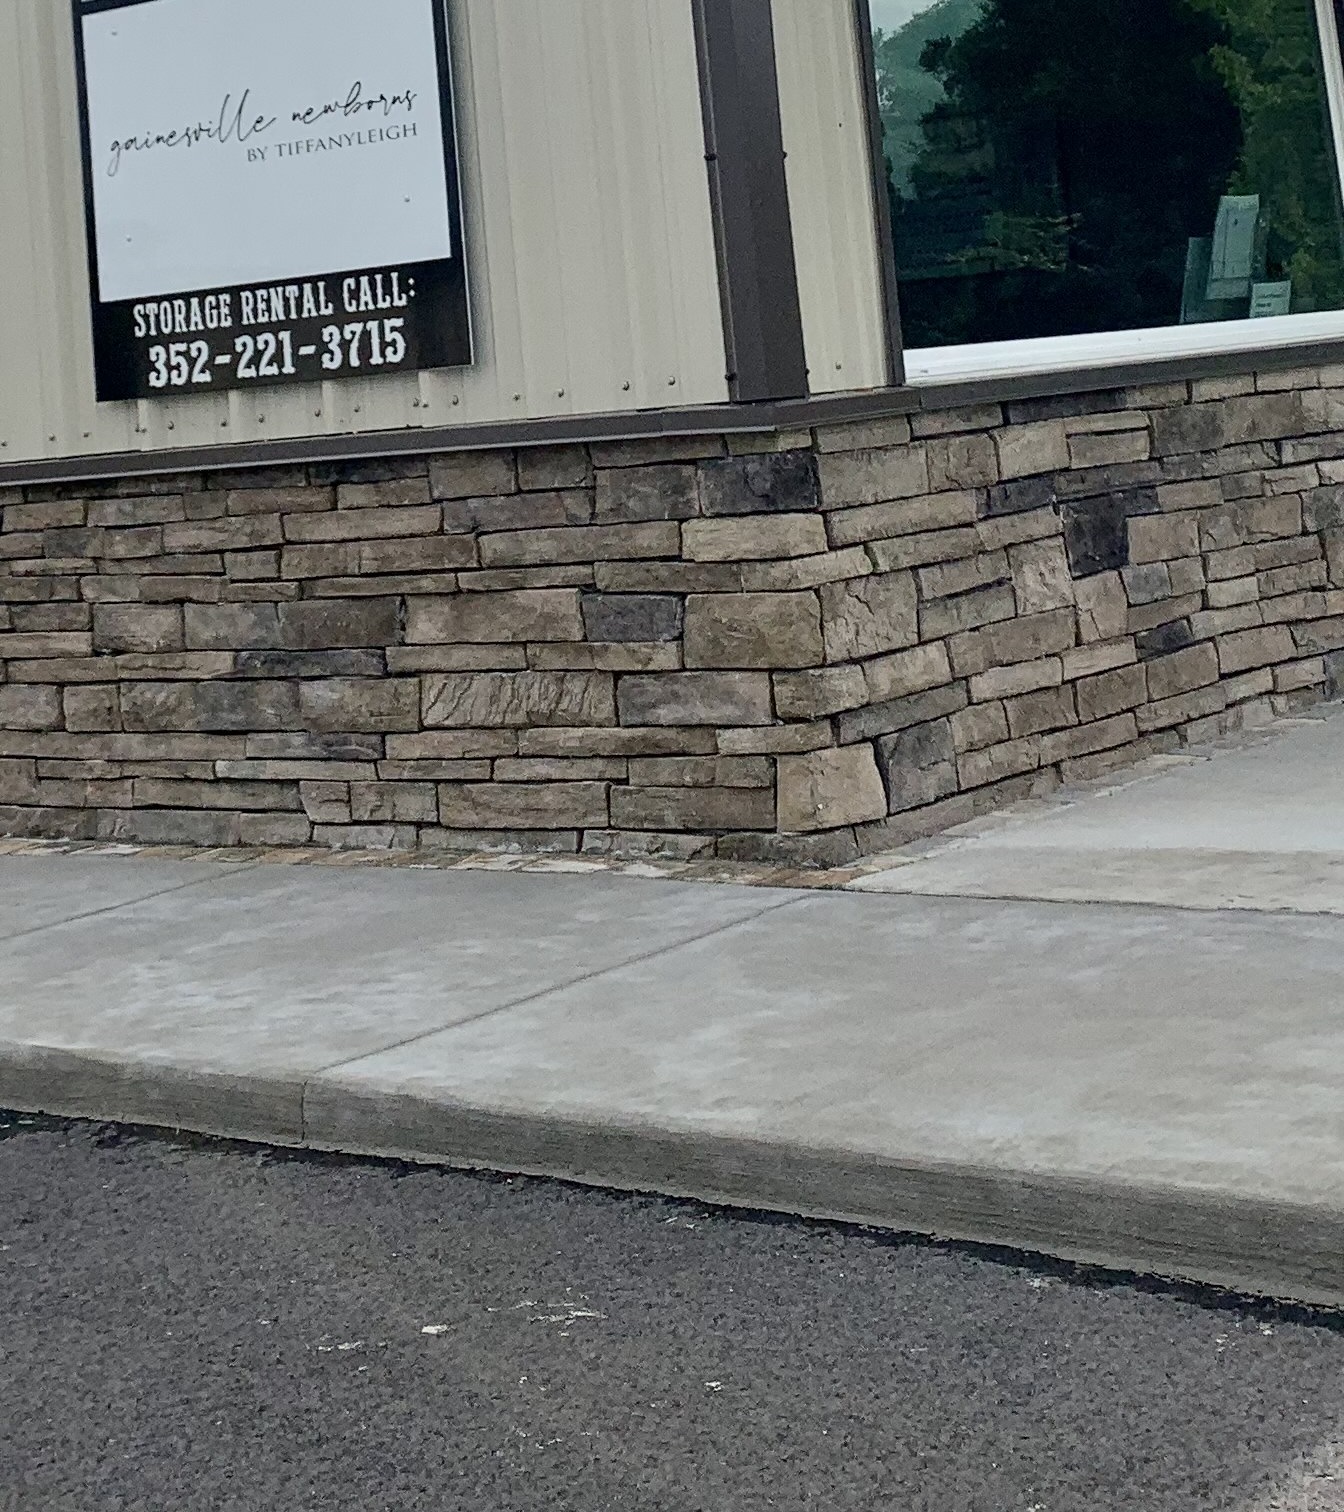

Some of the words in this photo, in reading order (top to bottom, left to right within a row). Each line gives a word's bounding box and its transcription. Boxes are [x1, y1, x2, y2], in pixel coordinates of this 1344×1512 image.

[106, 88, 278, 177] gainesville
[291, 81, 418, 124] newborns
[246, 146, 267, 163] BY
[274, 122, 418, 158] TIFFANYLEIGH
[132, 296, 233, 339] STORAGE
[239, 281, 334, 326] RENTAL
[342, 271, 417, 314] CALL:
[148, 317, 408, 389] 352-221-3715
